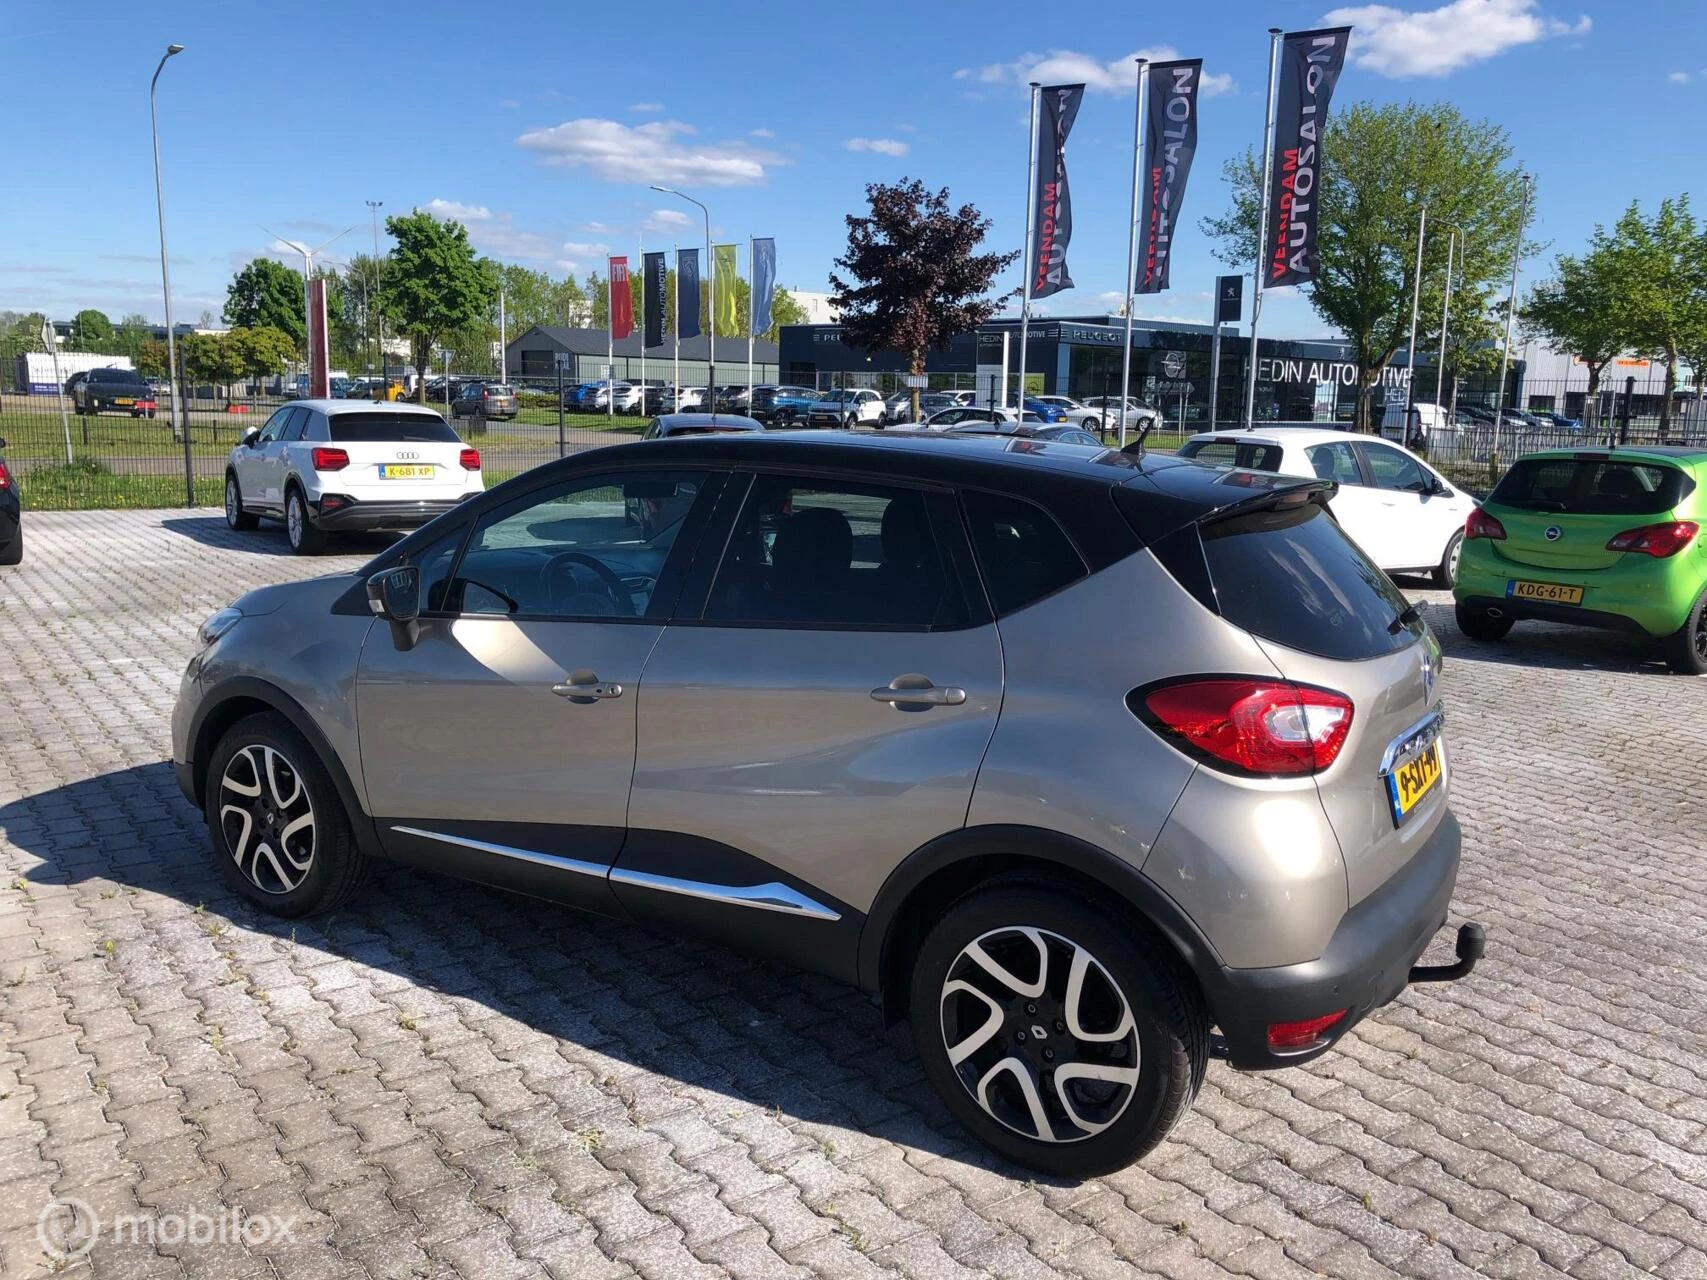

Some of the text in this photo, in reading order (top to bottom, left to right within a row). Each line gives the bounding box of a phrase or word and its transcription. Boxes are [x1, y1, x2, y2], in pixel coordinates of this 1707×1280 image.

[1272, 148, 1298, 279] VEENDAM
[1035, 183, 1056, 292] VEENDAM
[1073, 330, 1121, 342] PEUGEOT
[1243, 357, 1303, 383] HEDIN
[389, 467, 431, 476] K-681 XP
[1517, 583, 1577, 600] KDG-61-T
